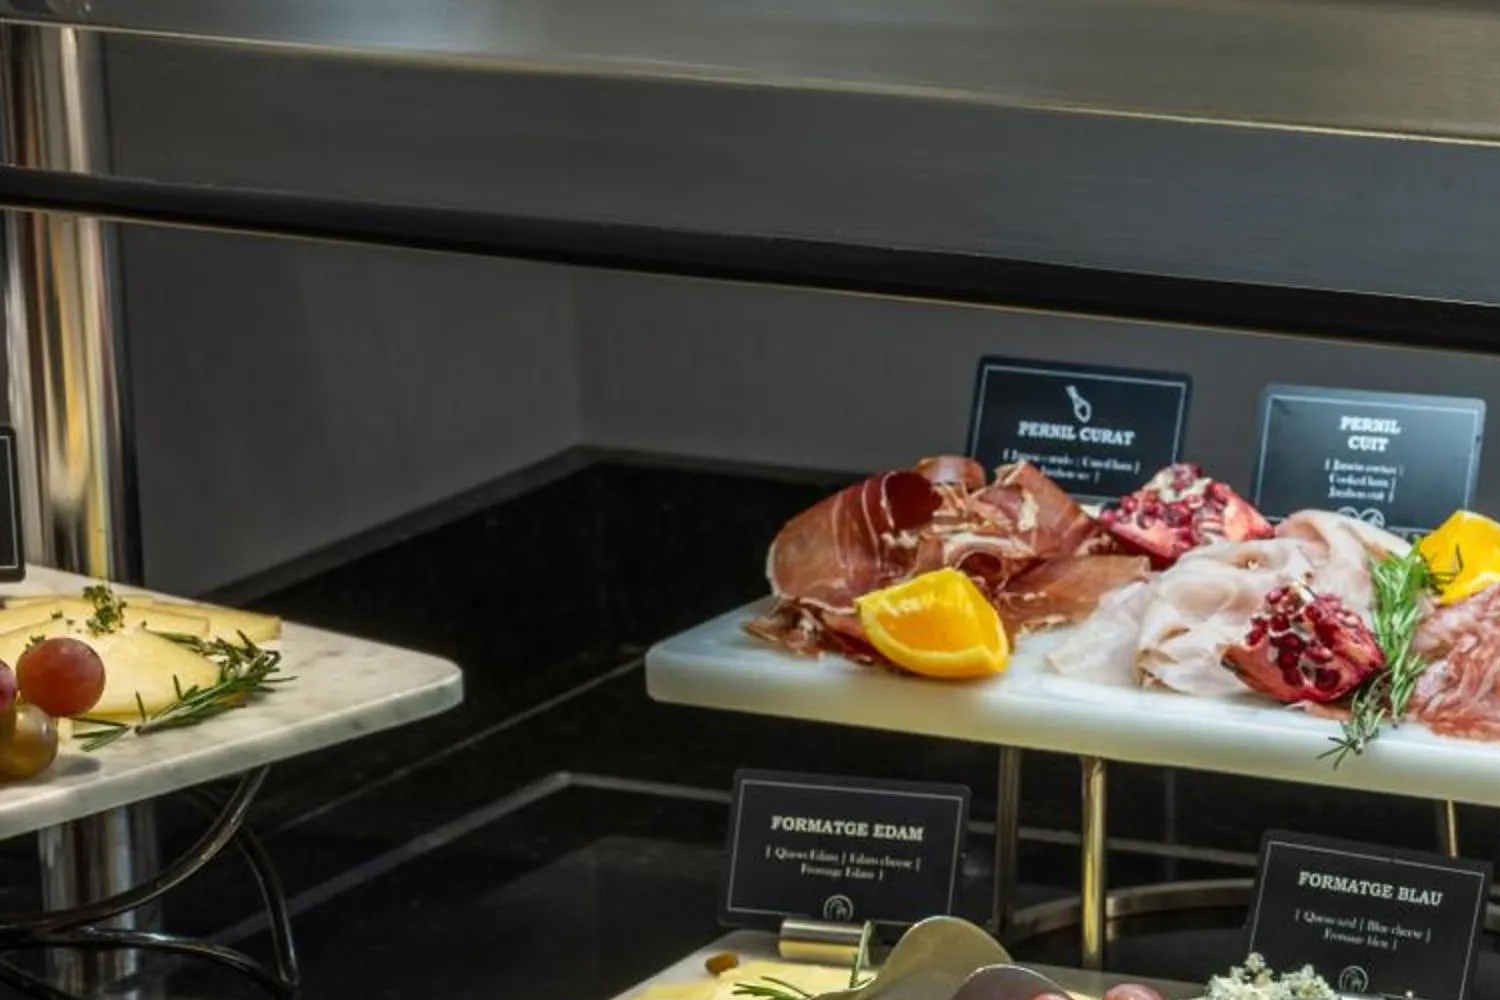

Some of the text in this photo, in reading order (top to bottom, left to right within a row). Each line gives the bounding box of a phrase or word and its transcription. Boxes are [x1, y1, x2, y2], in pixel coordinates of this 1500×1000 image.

[1017, 421, 1136, 445] PERNIL CURAT
[1340, 416, 1401, 433] PERNIL
[1348, 437, 1390, 451] CUIT
[770, 815, 925, 841] FORMATGE EDAM
[1298, 871, 1444, 906] FORMATGE BLAU
